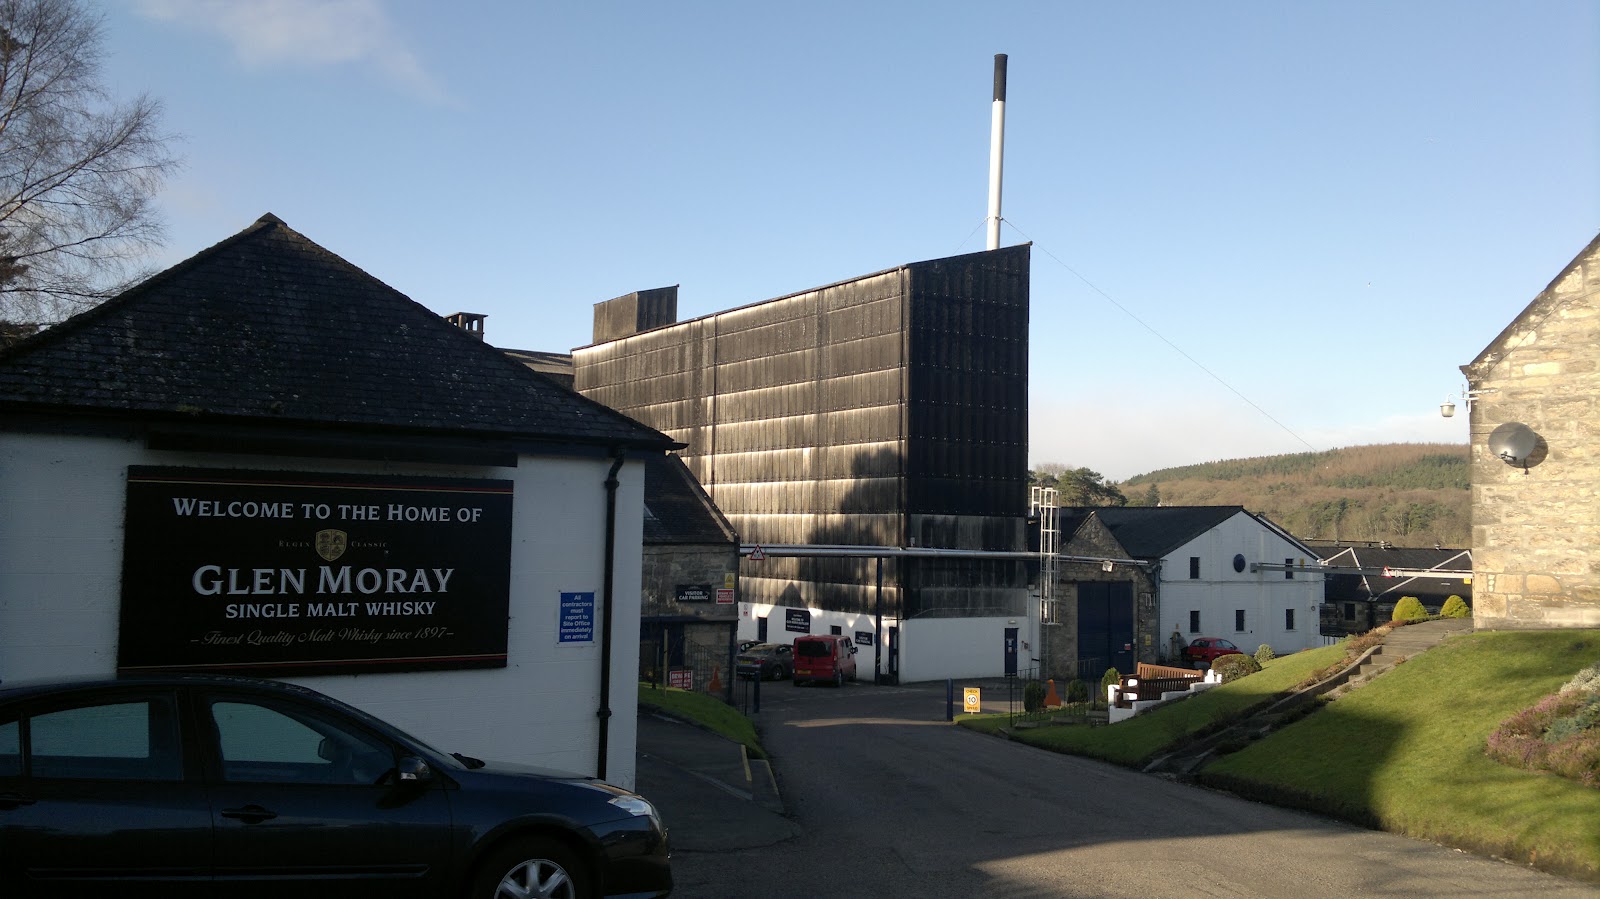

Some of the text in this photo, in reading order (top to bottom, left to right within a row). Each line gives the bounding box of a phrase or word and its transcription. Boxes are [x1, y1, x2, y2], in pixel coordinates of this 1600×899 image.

[172, 497, 483, 523] WELCOME TO THE HOME OF
[278, 540, 311, 548] ELGIN
[351, 540, 388, 548] CLASSIC
[192, 565, 455, 596] GLEN MORAY
[225, 601, 437, 619] SINGLE MALT WHISKY
[247, 629, 296, 647] Quality
[297, 628, 336, 642] Malt
[338, 627, 382, 644] Whisky
[385, 629, 412, 640] since
